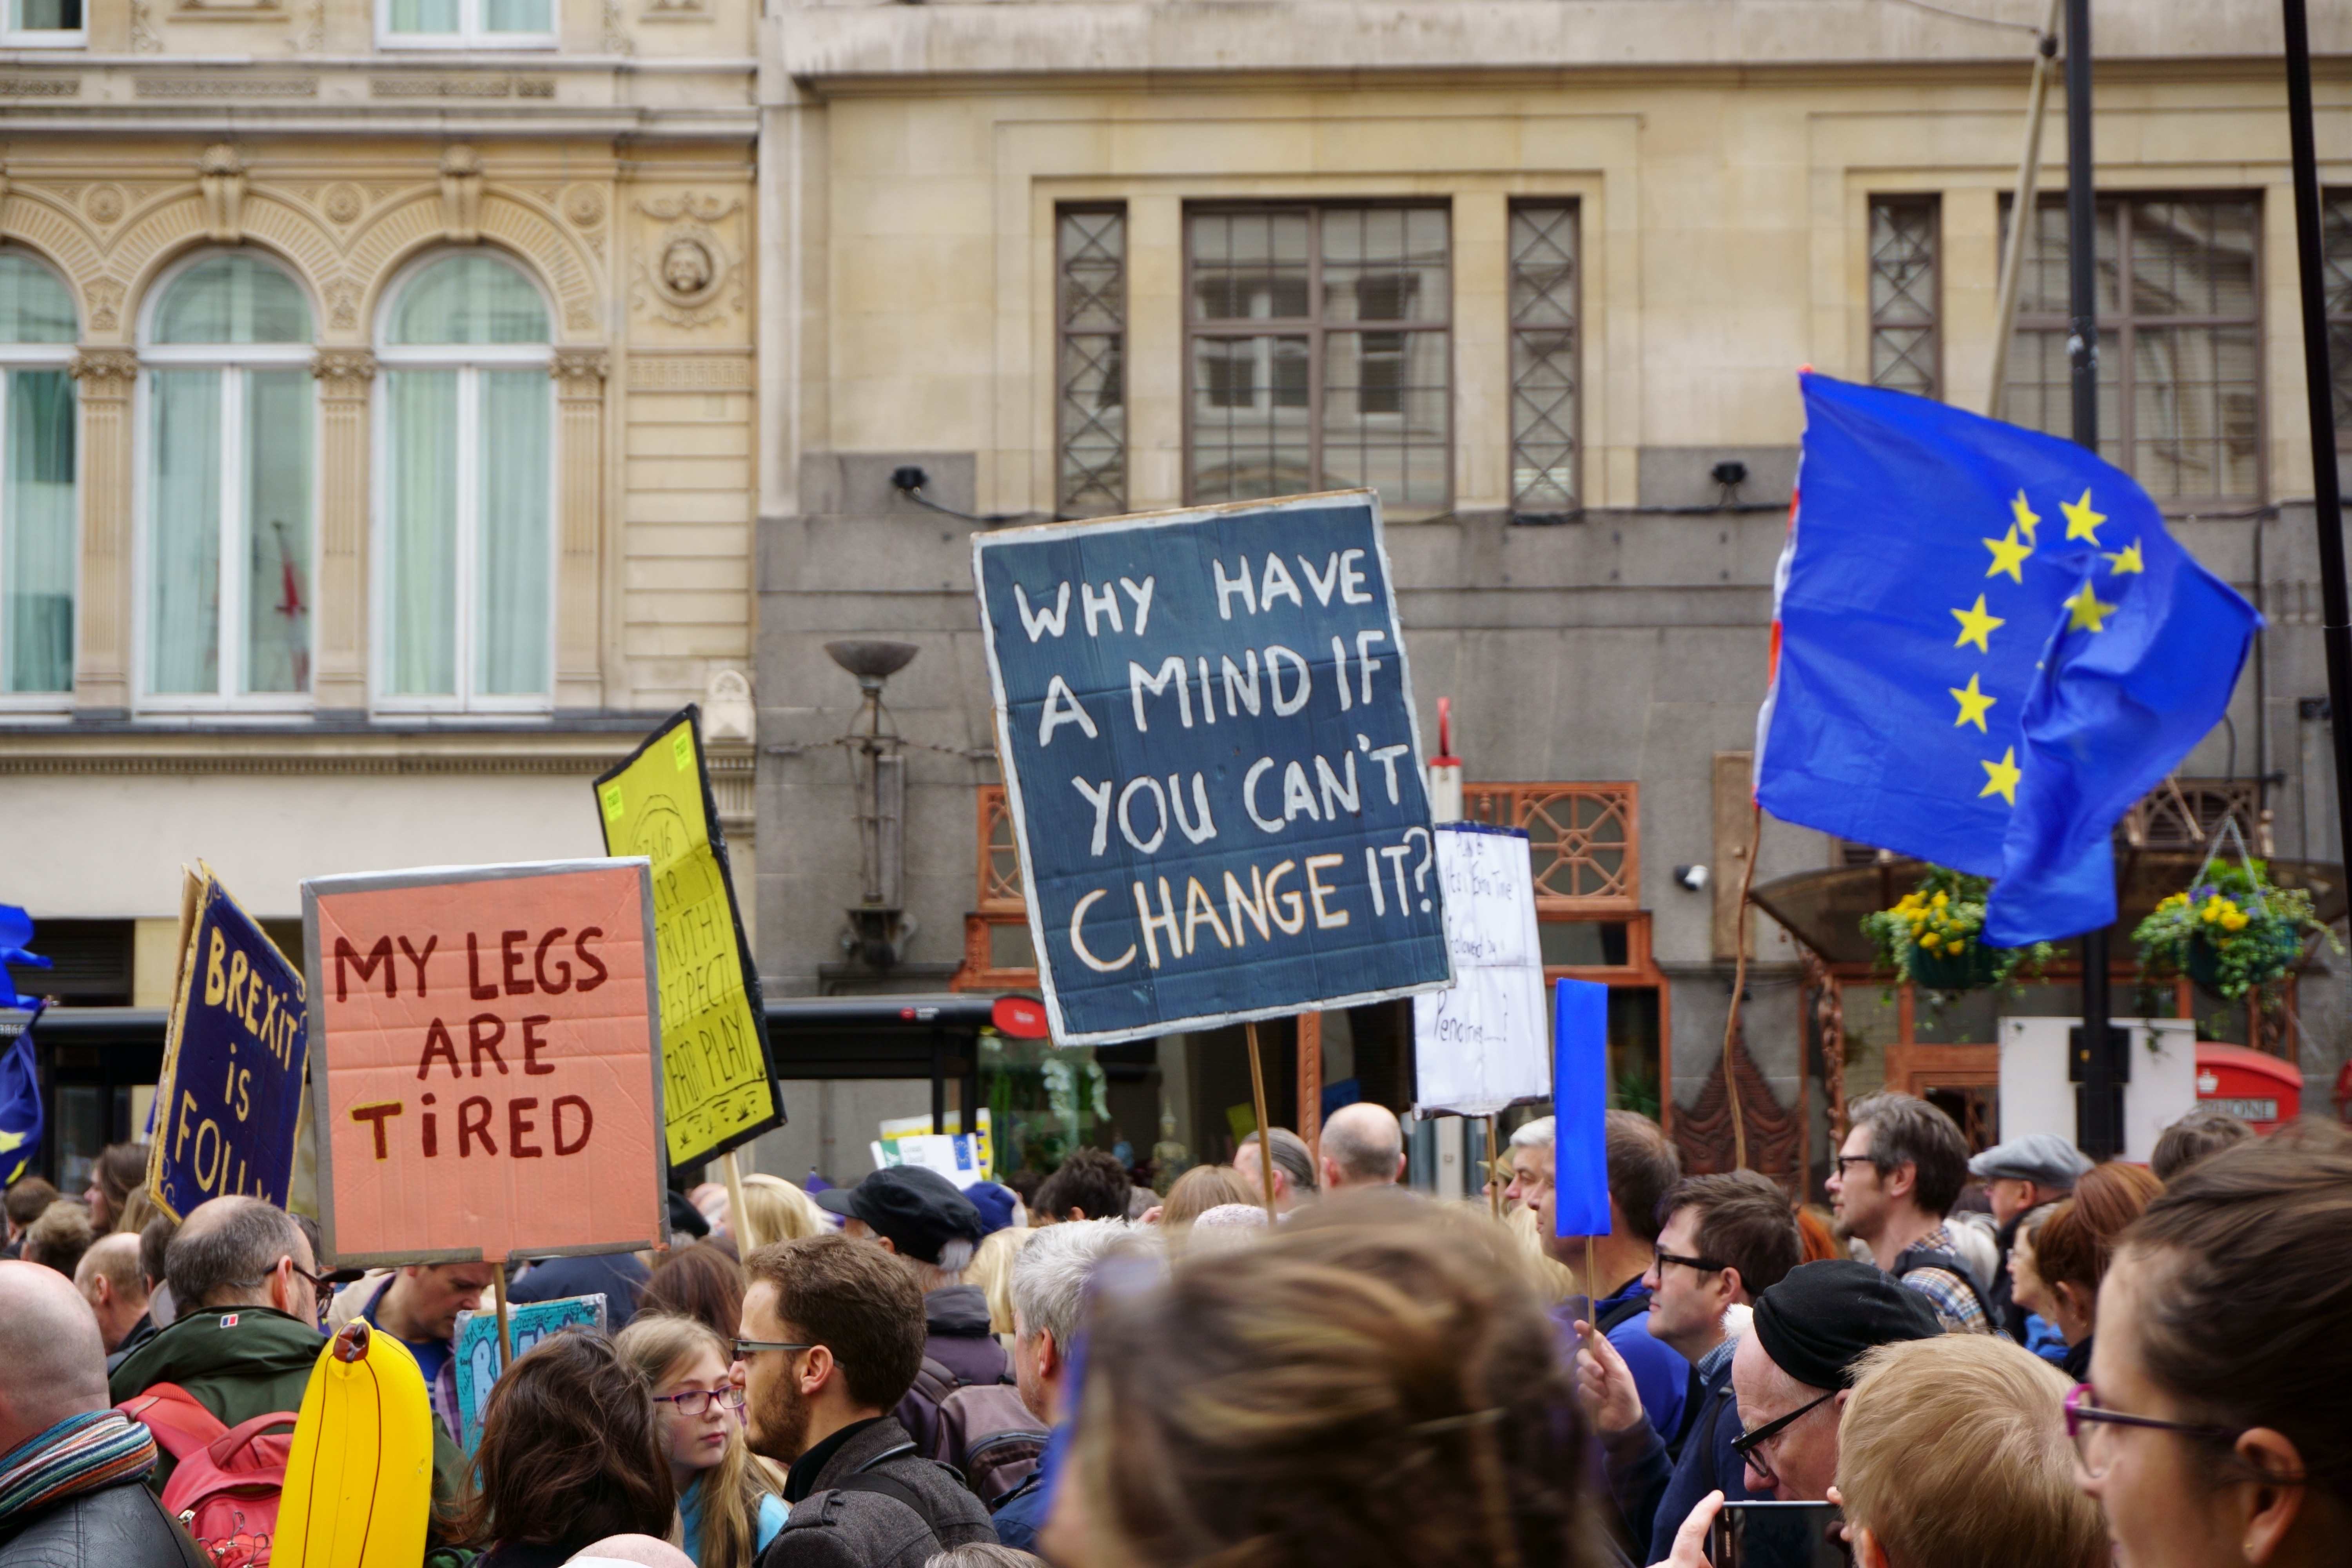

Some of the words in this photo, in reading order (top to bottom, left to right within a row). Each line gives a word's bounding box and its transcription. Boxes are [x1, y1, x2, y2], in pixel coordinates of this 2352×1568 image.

[1014, 576, 1154, 643] WHY
[1213, 549, 1373, 620] HAVE
[1039, 675, 1098, 747] A
[1129, 644, 1310, 732] MIND
[1332, 630, 1386, 711] IF
[1071, 771, 1217, 856] YOU
[1243, 733, 1409, 833] CAN'T
[1071, 854, 1349, 973] CHANGE
[1366, 826, 1433, 917] IT?
[335, 935, 437, 1002] MY
[467, 926, 608, 1000] LEGS
[417, 1013, 555, 1080] ARE
[699, 1009, 747, 1087] PLAY
